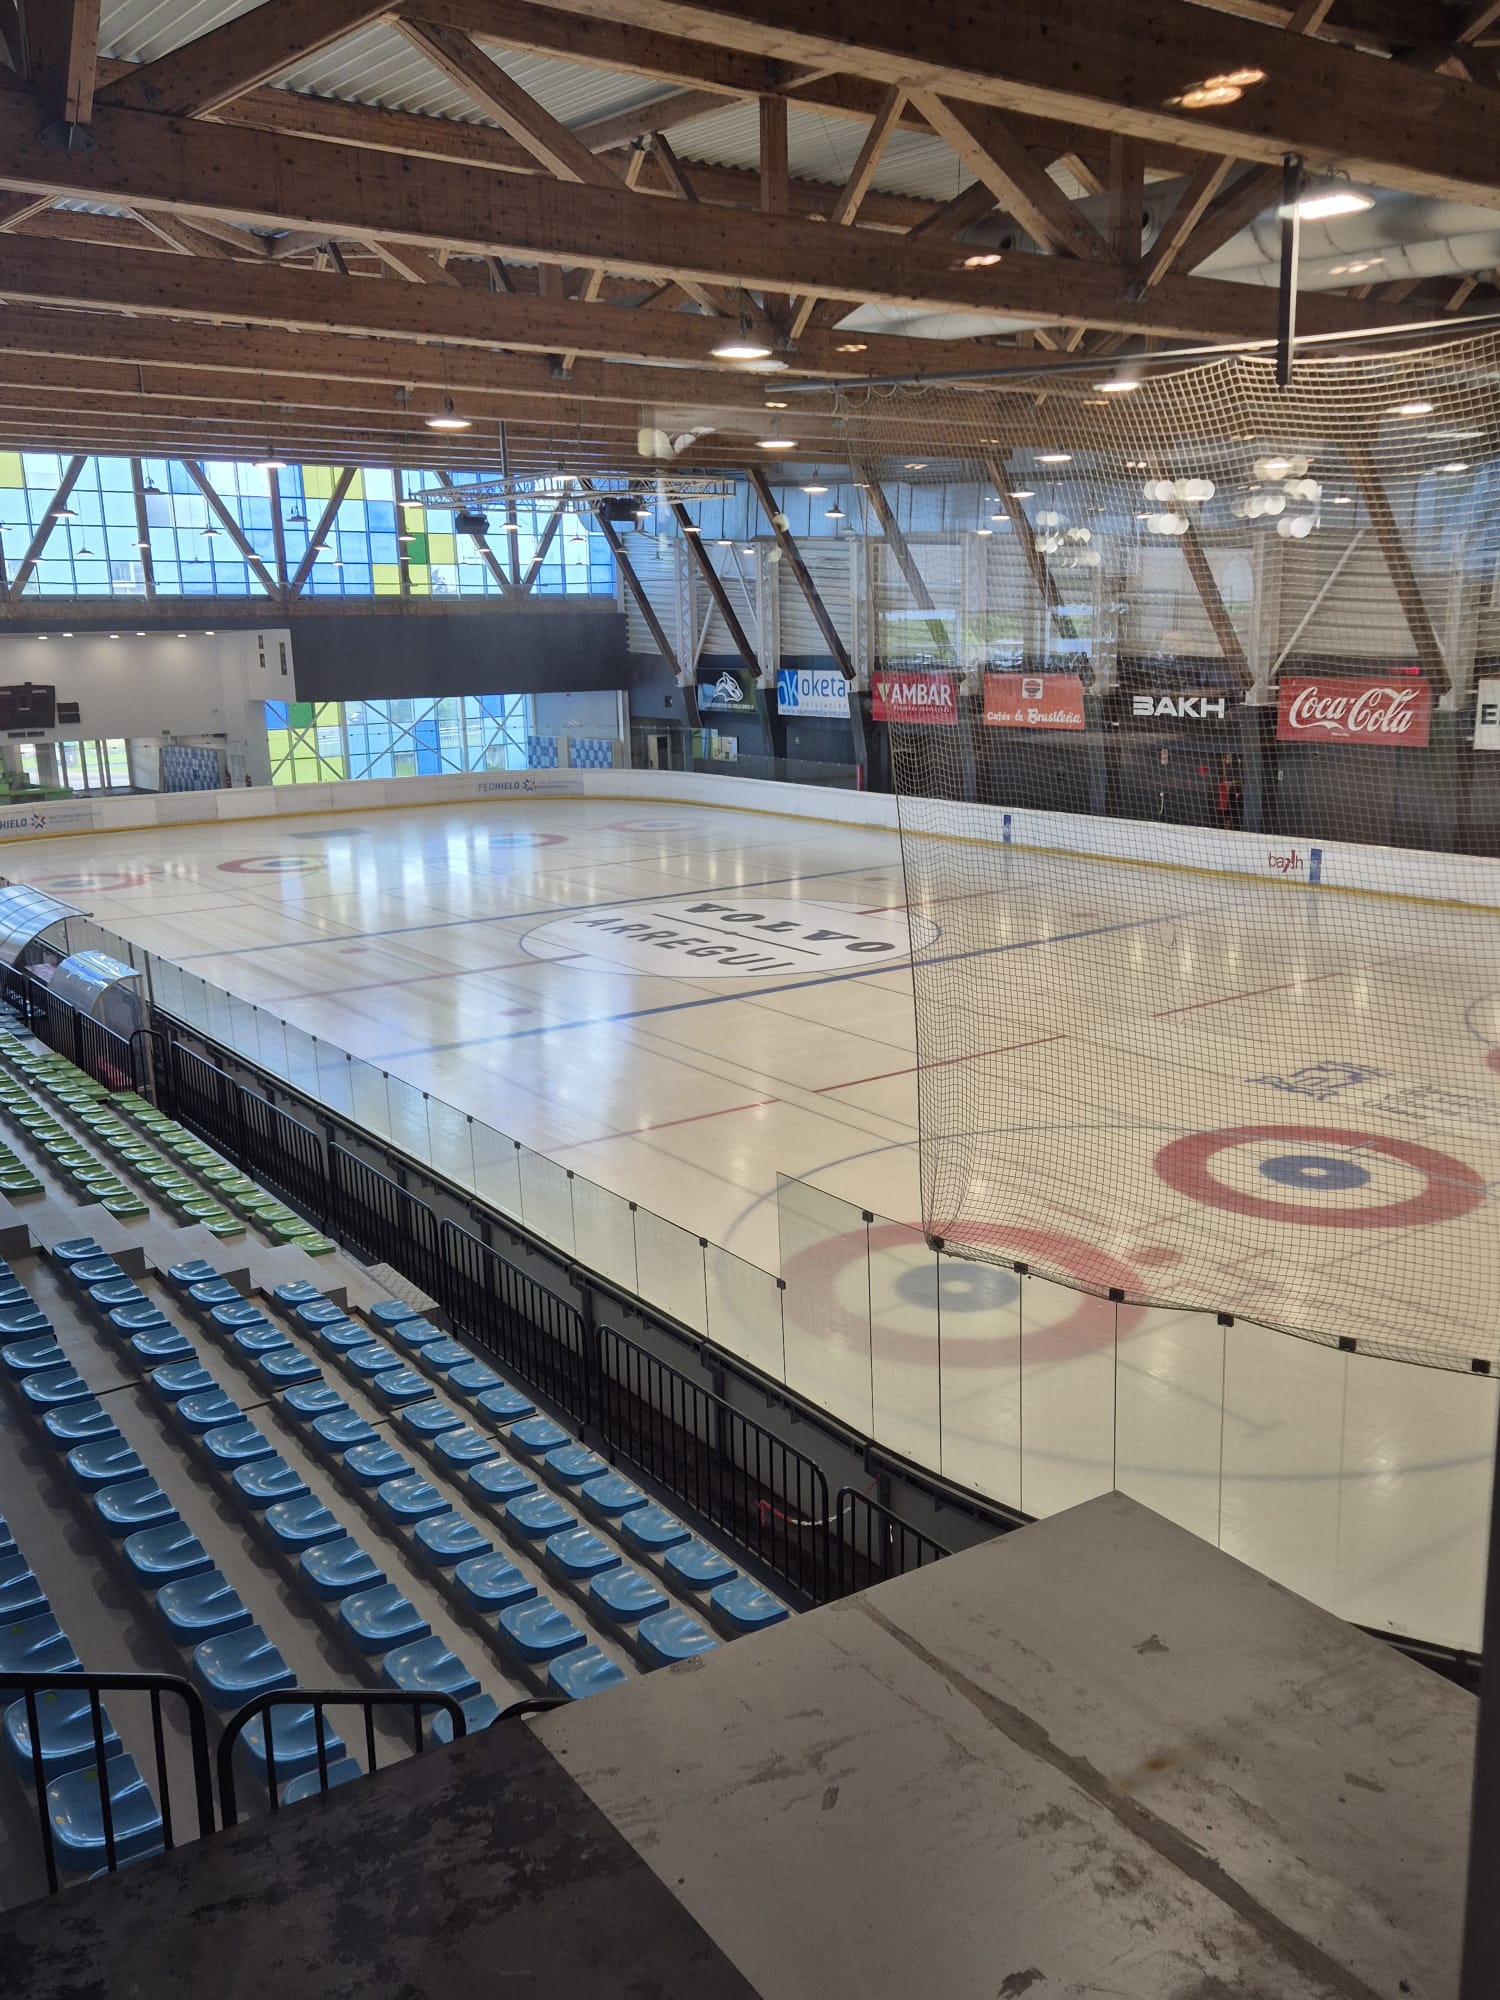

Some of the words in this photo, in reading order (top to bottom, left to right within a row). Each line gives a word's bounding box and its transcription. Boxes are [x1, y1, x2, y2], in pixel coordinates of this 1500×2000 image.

[802, 671, 846, 698] oketa
[890, 683, 953, 706] AMBAR
[1132, 695, 1225, 719] BAKH
[1289, 686, 1420, 734] Coca-Cola
[573, 917, 796, 972] ARREGUI
[685, 902, 896, 953] VOLVO
